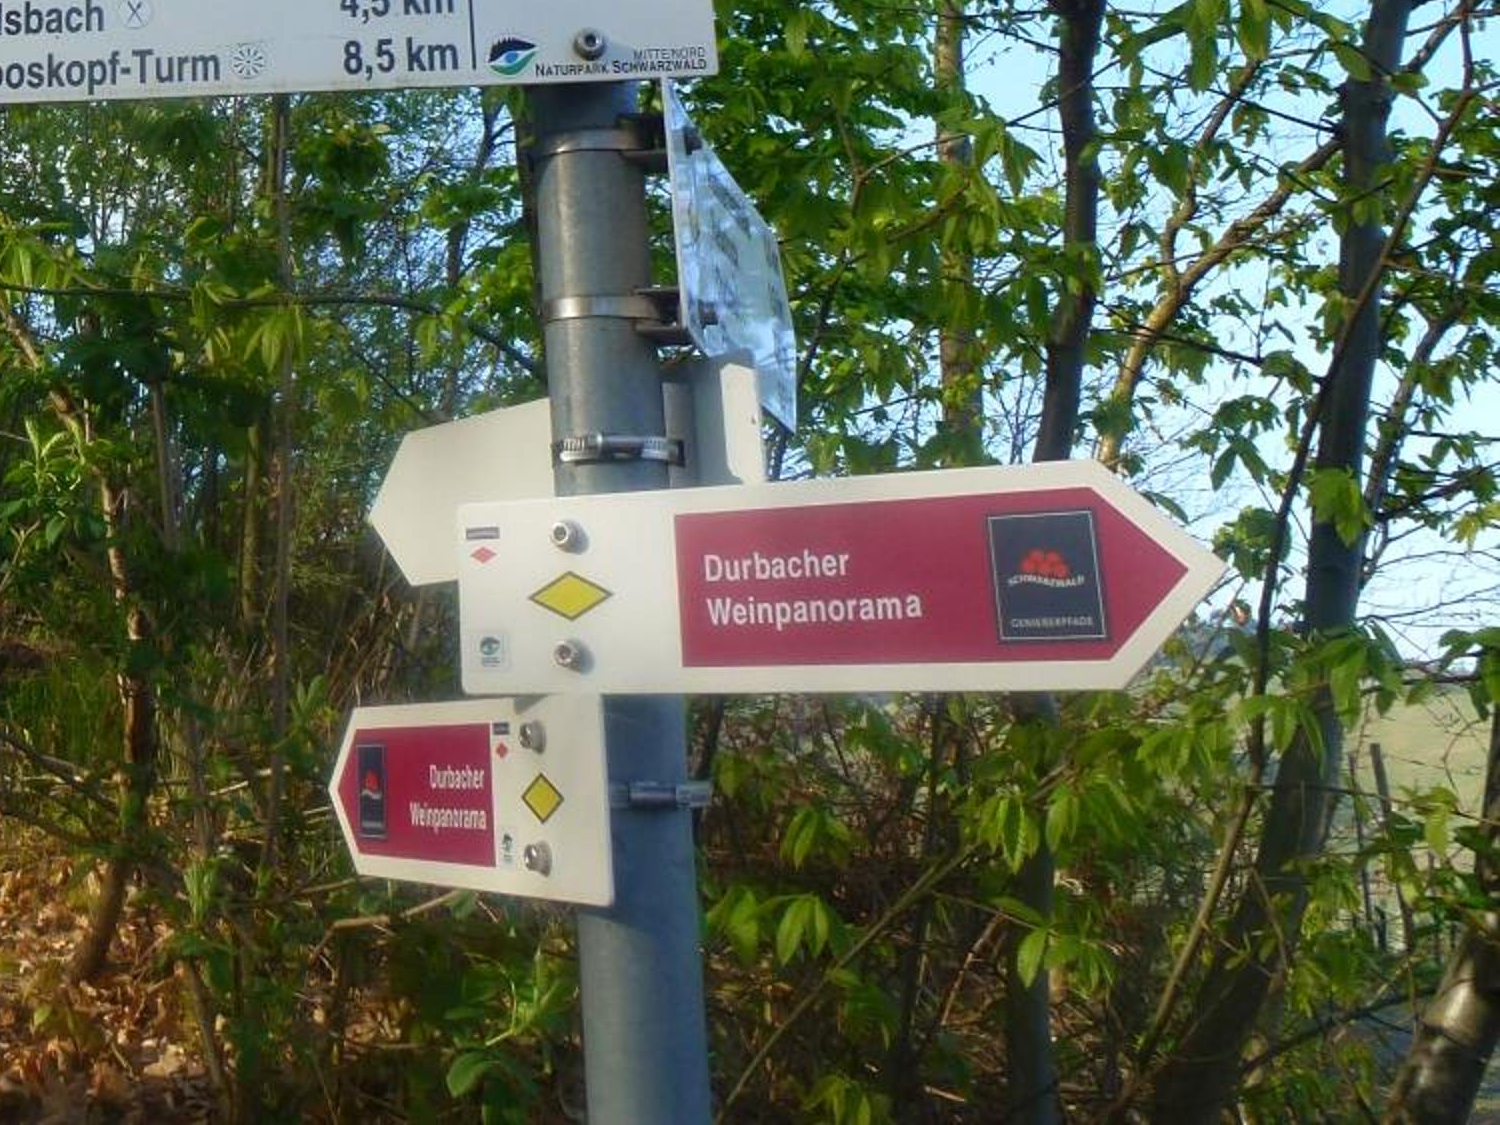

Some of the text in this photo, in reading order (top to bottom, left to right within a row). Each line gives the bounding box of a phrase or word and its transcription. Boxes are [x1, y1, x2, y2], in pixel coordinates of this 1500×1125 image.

[344, 40, 395, 79] 8,5
[406, 37, 458, 72] km
[704, 550, 849, 582] Durbacher
[707, 594, 922, 631] Weinpanorama
[429, 765, 484, 789] Durbacher
[410, 803, 486, 834] Weinpanorama
